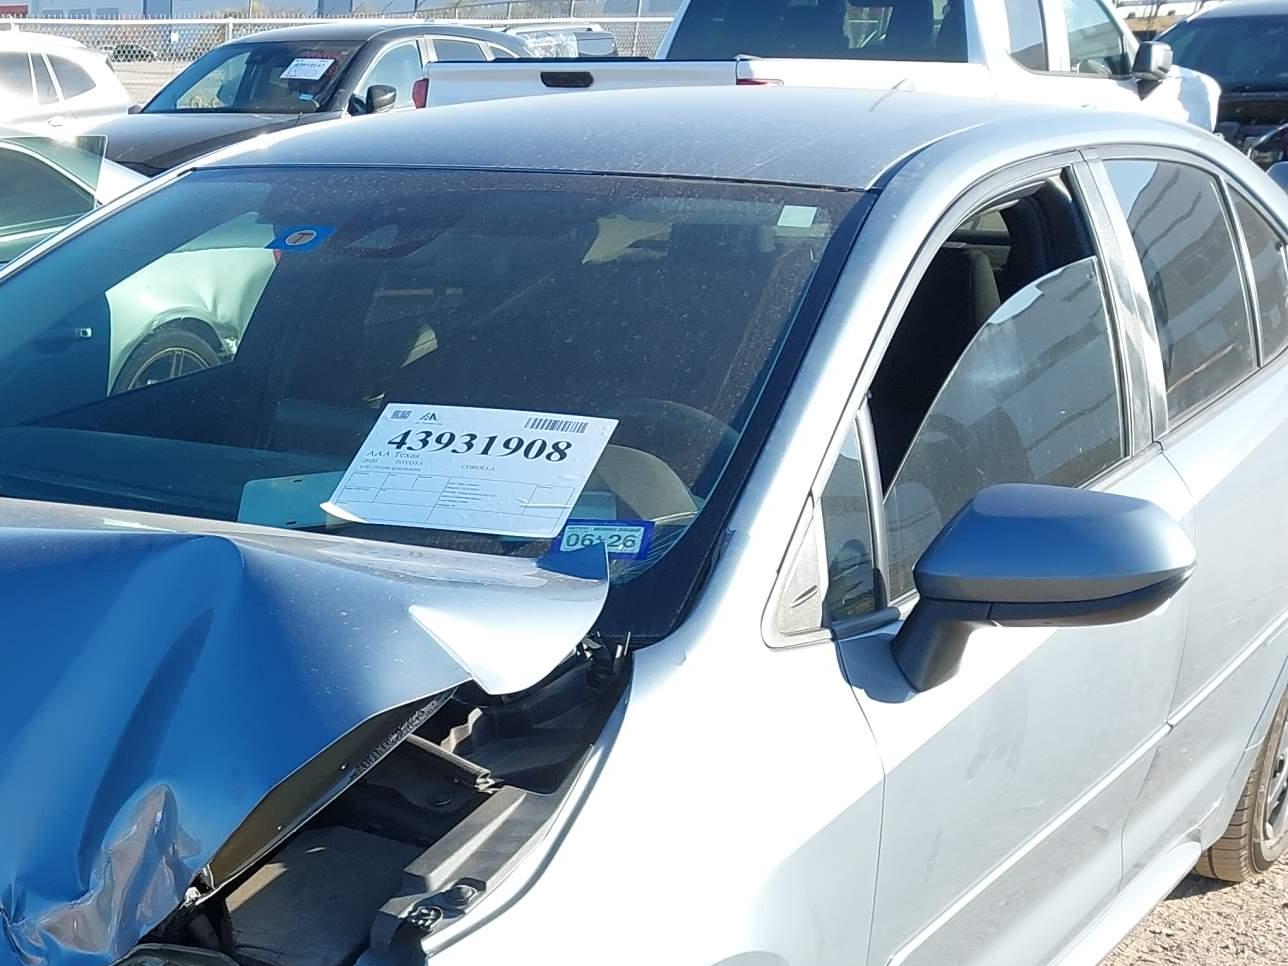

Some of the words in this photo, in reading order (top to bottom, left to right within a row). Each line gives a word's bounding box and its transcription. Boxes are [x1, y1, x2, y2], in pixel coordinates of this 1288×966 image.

[387, 429, 573, 463] 43931908
[394, 451, 421, 459] Texas
[607, 534, 637, 548] 26
